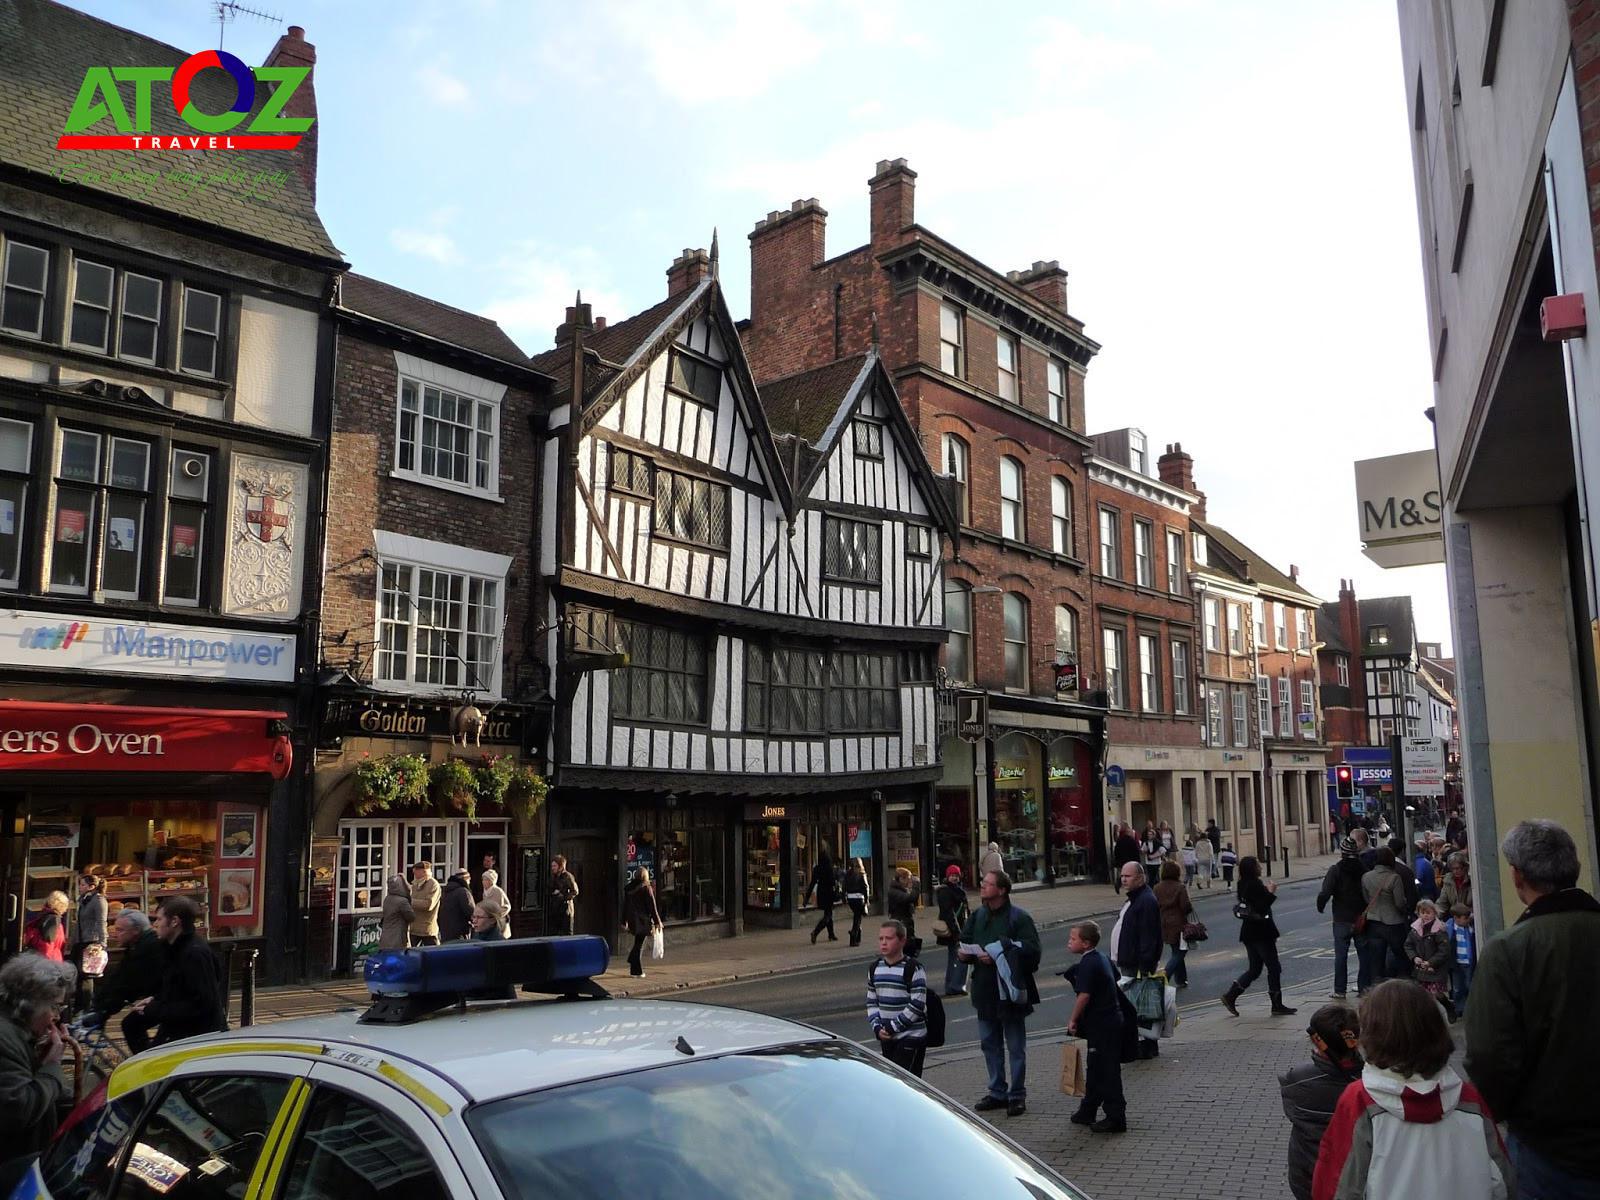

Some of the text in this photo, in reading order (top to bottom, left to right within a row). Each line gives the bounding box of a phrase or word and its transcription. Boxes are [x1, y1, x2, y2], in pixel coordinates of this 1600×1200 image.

[1363, 491, 1441, 532] M&S
[113, 625, 286, 666] Manpower
[1056, 674, 1076, 686] Pizza
[360, 709, 426, 734] Golden
[0, 723, 165, 755] ers Oven
